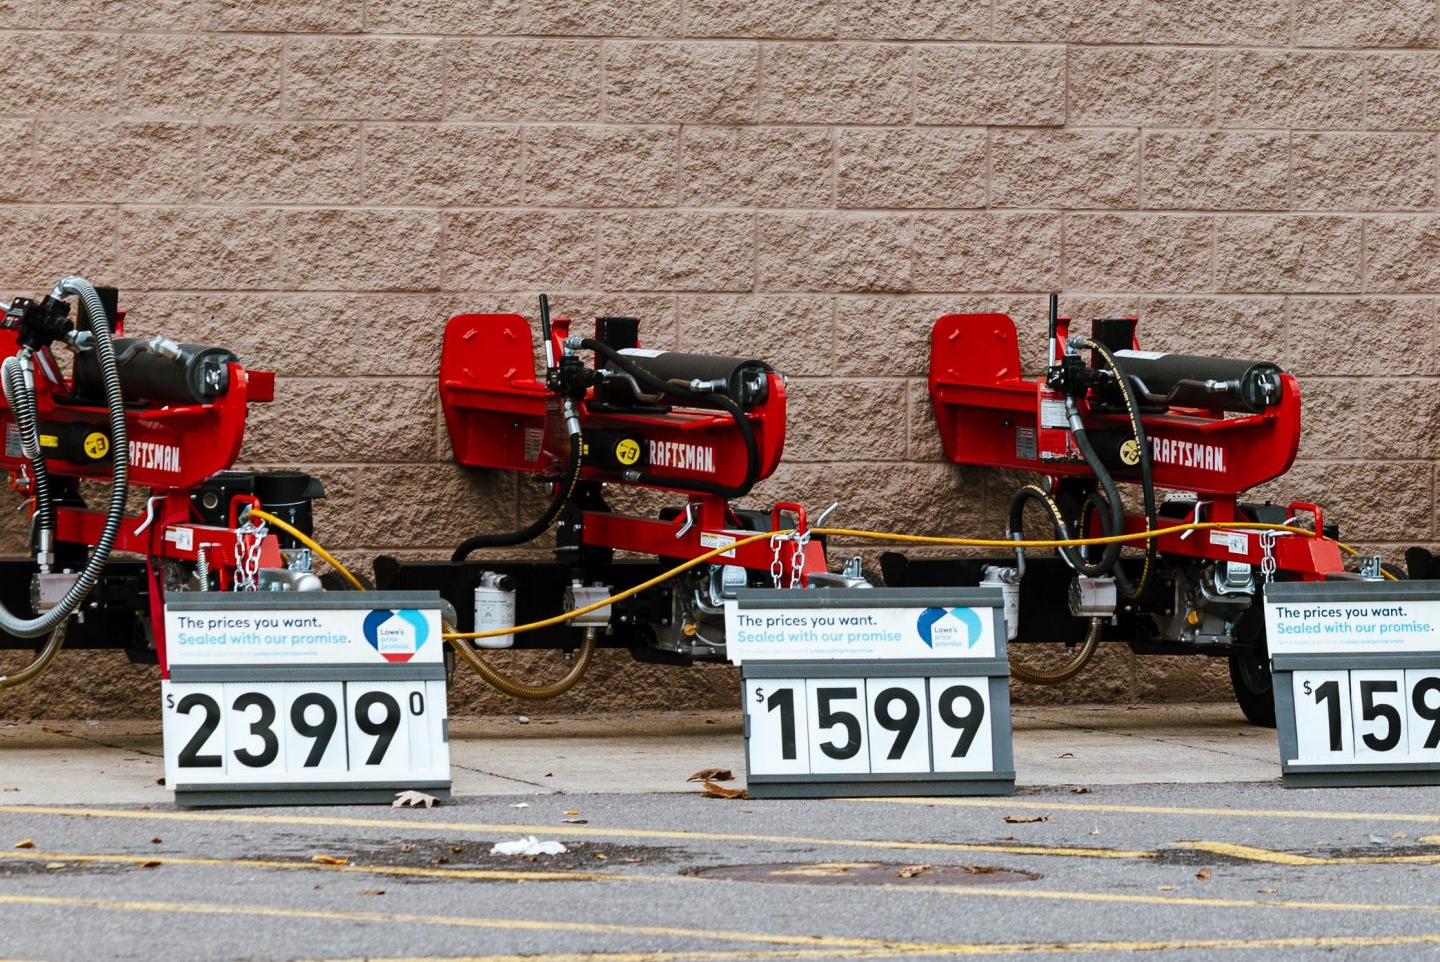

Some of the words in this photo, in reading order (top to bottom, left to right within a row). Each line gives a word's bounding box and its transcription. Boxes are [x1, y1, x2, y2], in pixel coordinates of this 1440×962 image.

[1276, 607, 1300, 618] The
[1303, 606, 1342, 620] prices
[1345, 608, 1368, 620] you
[1371, 606, 1407, 617] want.
[178, 617, 204, 628] The
[208, 616, 250, 630] prices
[254, 619, 279, 630] you
[282, 616, 322, 628] want.
[737, 615, 763, 626] The
[766, 614, 807, 628] prices
[811, 617, 835, 628] you
[839, 614, 877, 626] want.
[1277, 622, 1321, 634] Sealed
[1324, 621, 1352, 633] with
[1355, 623, 1376, 633] our
[1379, 620, 1434, 635] promise.
[380, 628, 405, 636] Lowe's
[934, 625, 957, 633] Lowe's
[178, 632, 227, 645] Sealed
[230, 631, 261, 644] with
[264, 634, 287, 644] our
[291, 631, 352, 647] promise.
[737, 630, 785, 643] Sealed
[787, 629, 818, 642] with
[821, 632, 844, 642] our
[847, 629, 902, 644] promise
[755, 684, 985, 761] $1599
